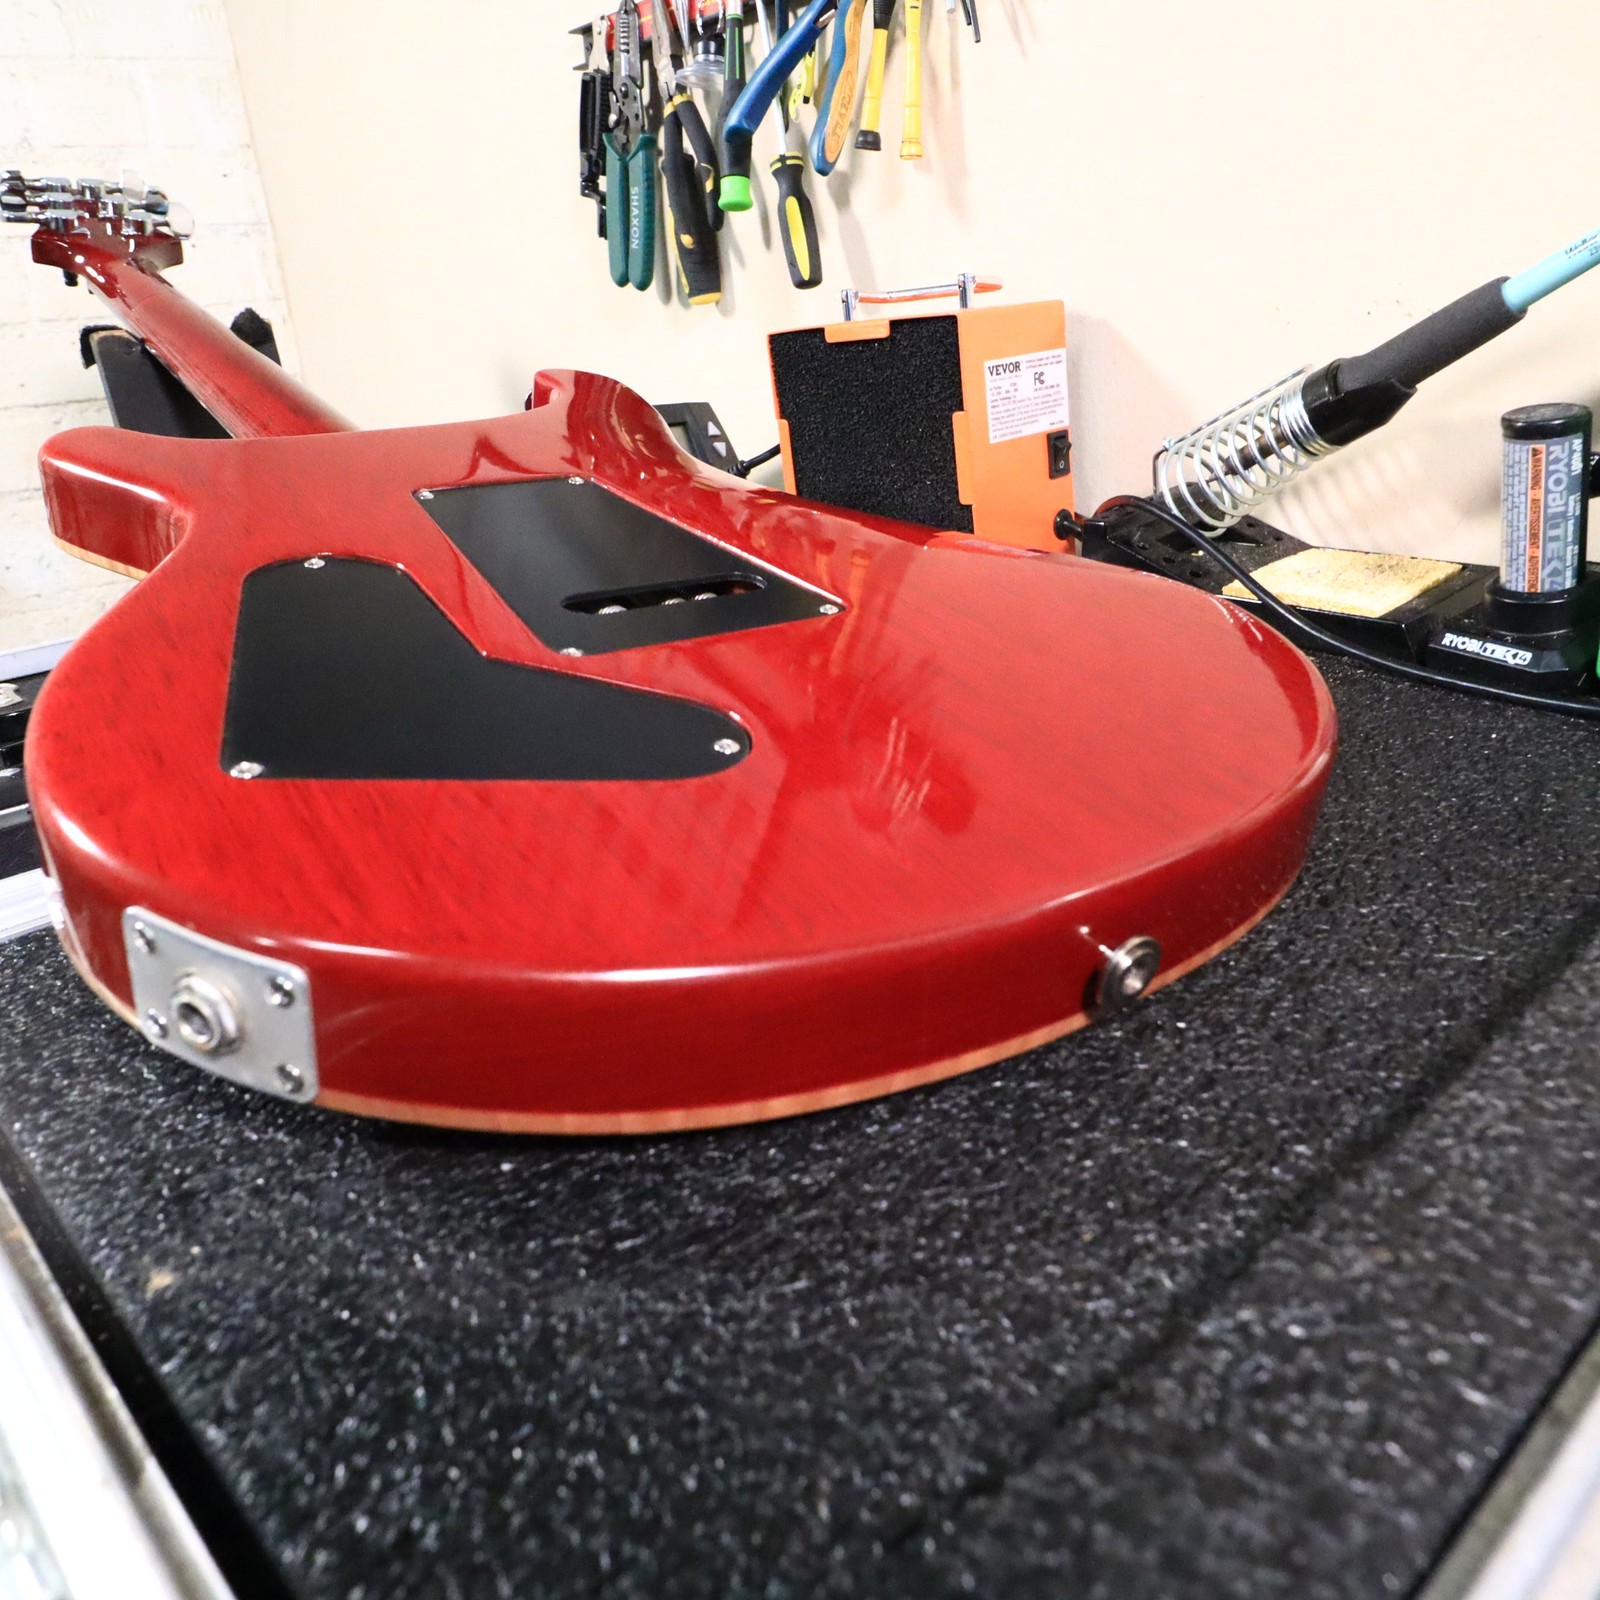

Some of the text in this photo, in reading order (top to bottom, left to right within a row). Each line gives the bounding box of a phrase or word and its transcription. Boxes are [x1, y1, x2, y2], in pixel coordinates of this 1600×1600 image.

[630, 186, 640, 250] SHAXON
[988, 361, 1021, 377] VEVOR
[1530, 456, 1542, 490] WARNING
[1547, 441, 1570, 513] RYOBI
[1528, 498, 1541, 549] AVERTISSEMENT
[1441, 632, 1482, 653] RYOBI
